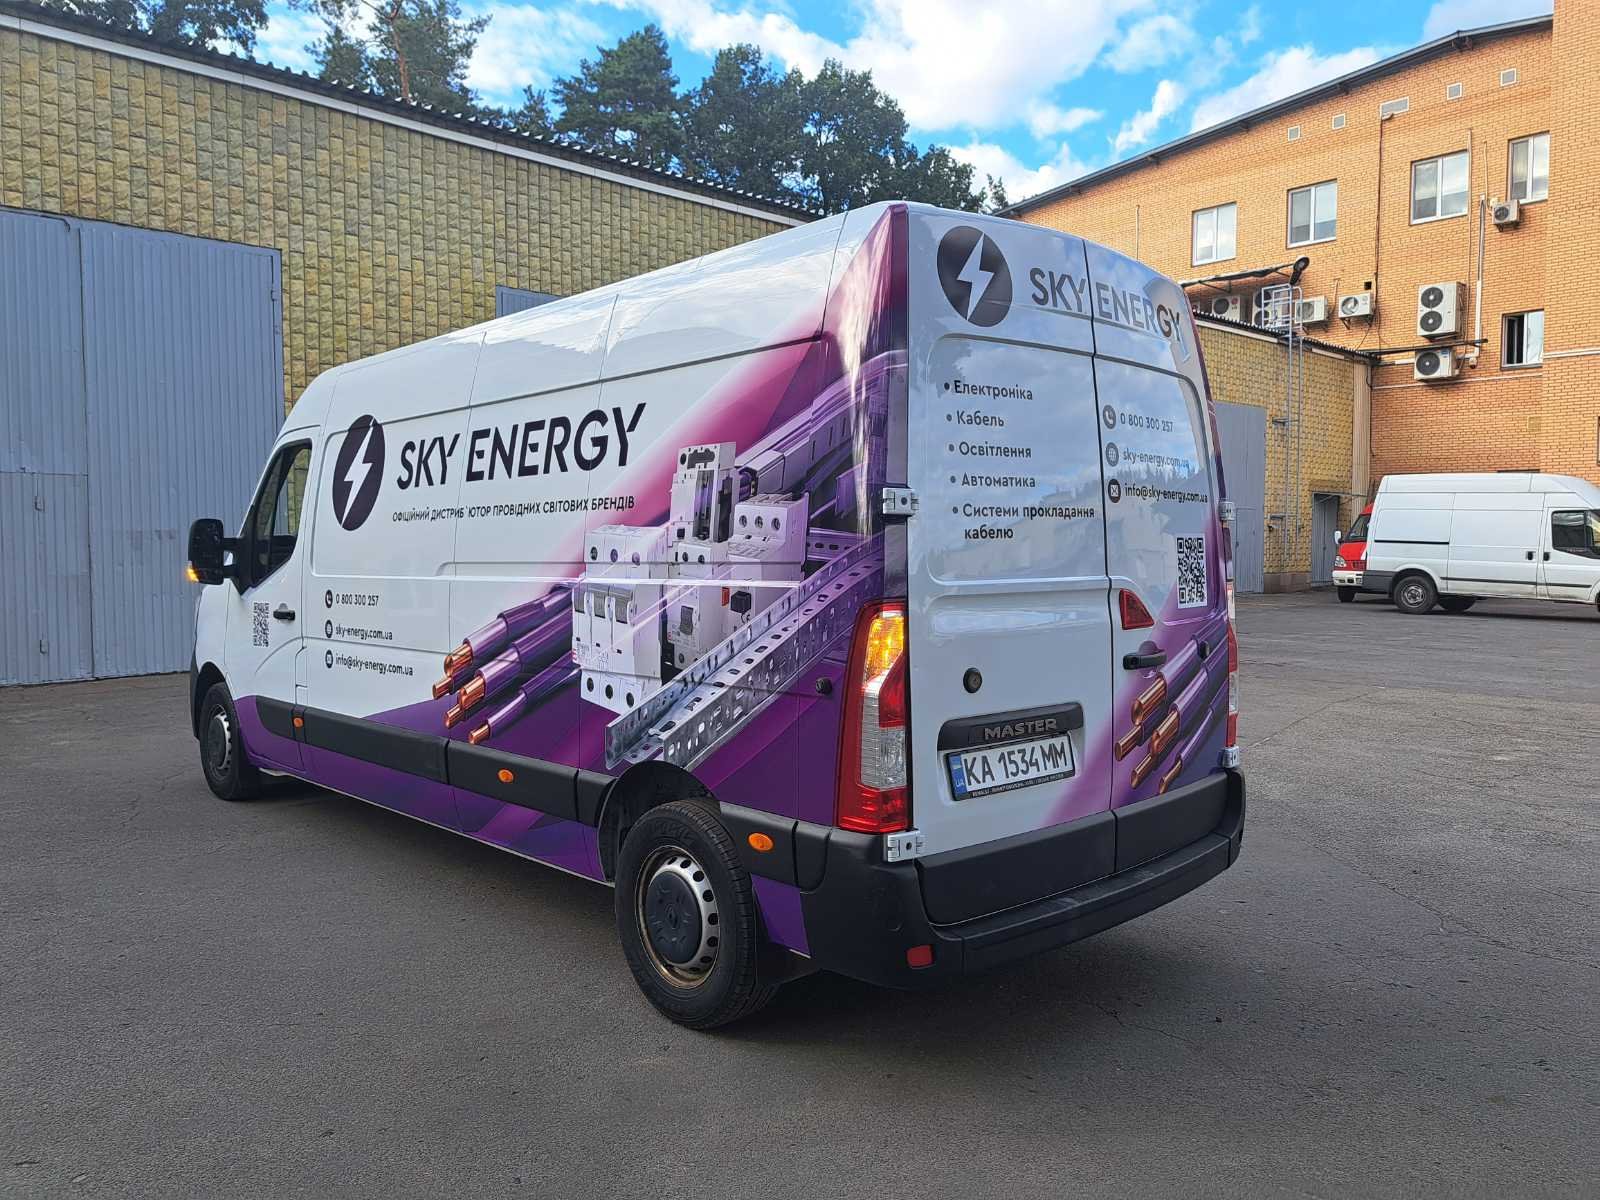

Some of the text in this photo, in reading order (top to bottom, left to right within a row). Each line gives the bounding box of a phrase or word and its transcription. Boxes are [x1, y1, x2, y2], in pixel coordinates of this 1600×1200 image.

[1029, 267, 1180, 343] SKY ENERGY
[953, 379, 1033, 400] Електроніка
[956, 410, 1005, 427] Кабель
[1120, 413, 1174, 432] 0 800 300 257
[396, 402, 647, 490] SKY ENERGY
[958, 441, 1032, 458] Освітлення
[1123, 448, 1190, 468] sky-energy.com.ua
[961, 472, 1036, 487] Автоматика
[1124, 483, 1208, 503] info@sky-energy.com.ua
[492, 502, 541, 517] ПРОВІДНИХ
[543, 499, 589, 513] СВІТОВИХ
[591, 496, 635, 511] БРЕНДІВ
[962, 503, 1095, 520] Системи прокладання
[964, 524, 1014, 539] кабелю
[335, 593, 379, 606] 0 800 300 257
[335, 624, 393, 640] sky-energy.com.ua
[335, 653, 413, 676] info@sky-energy.com.ua
[984, 718, 1057, 740] MASTER
